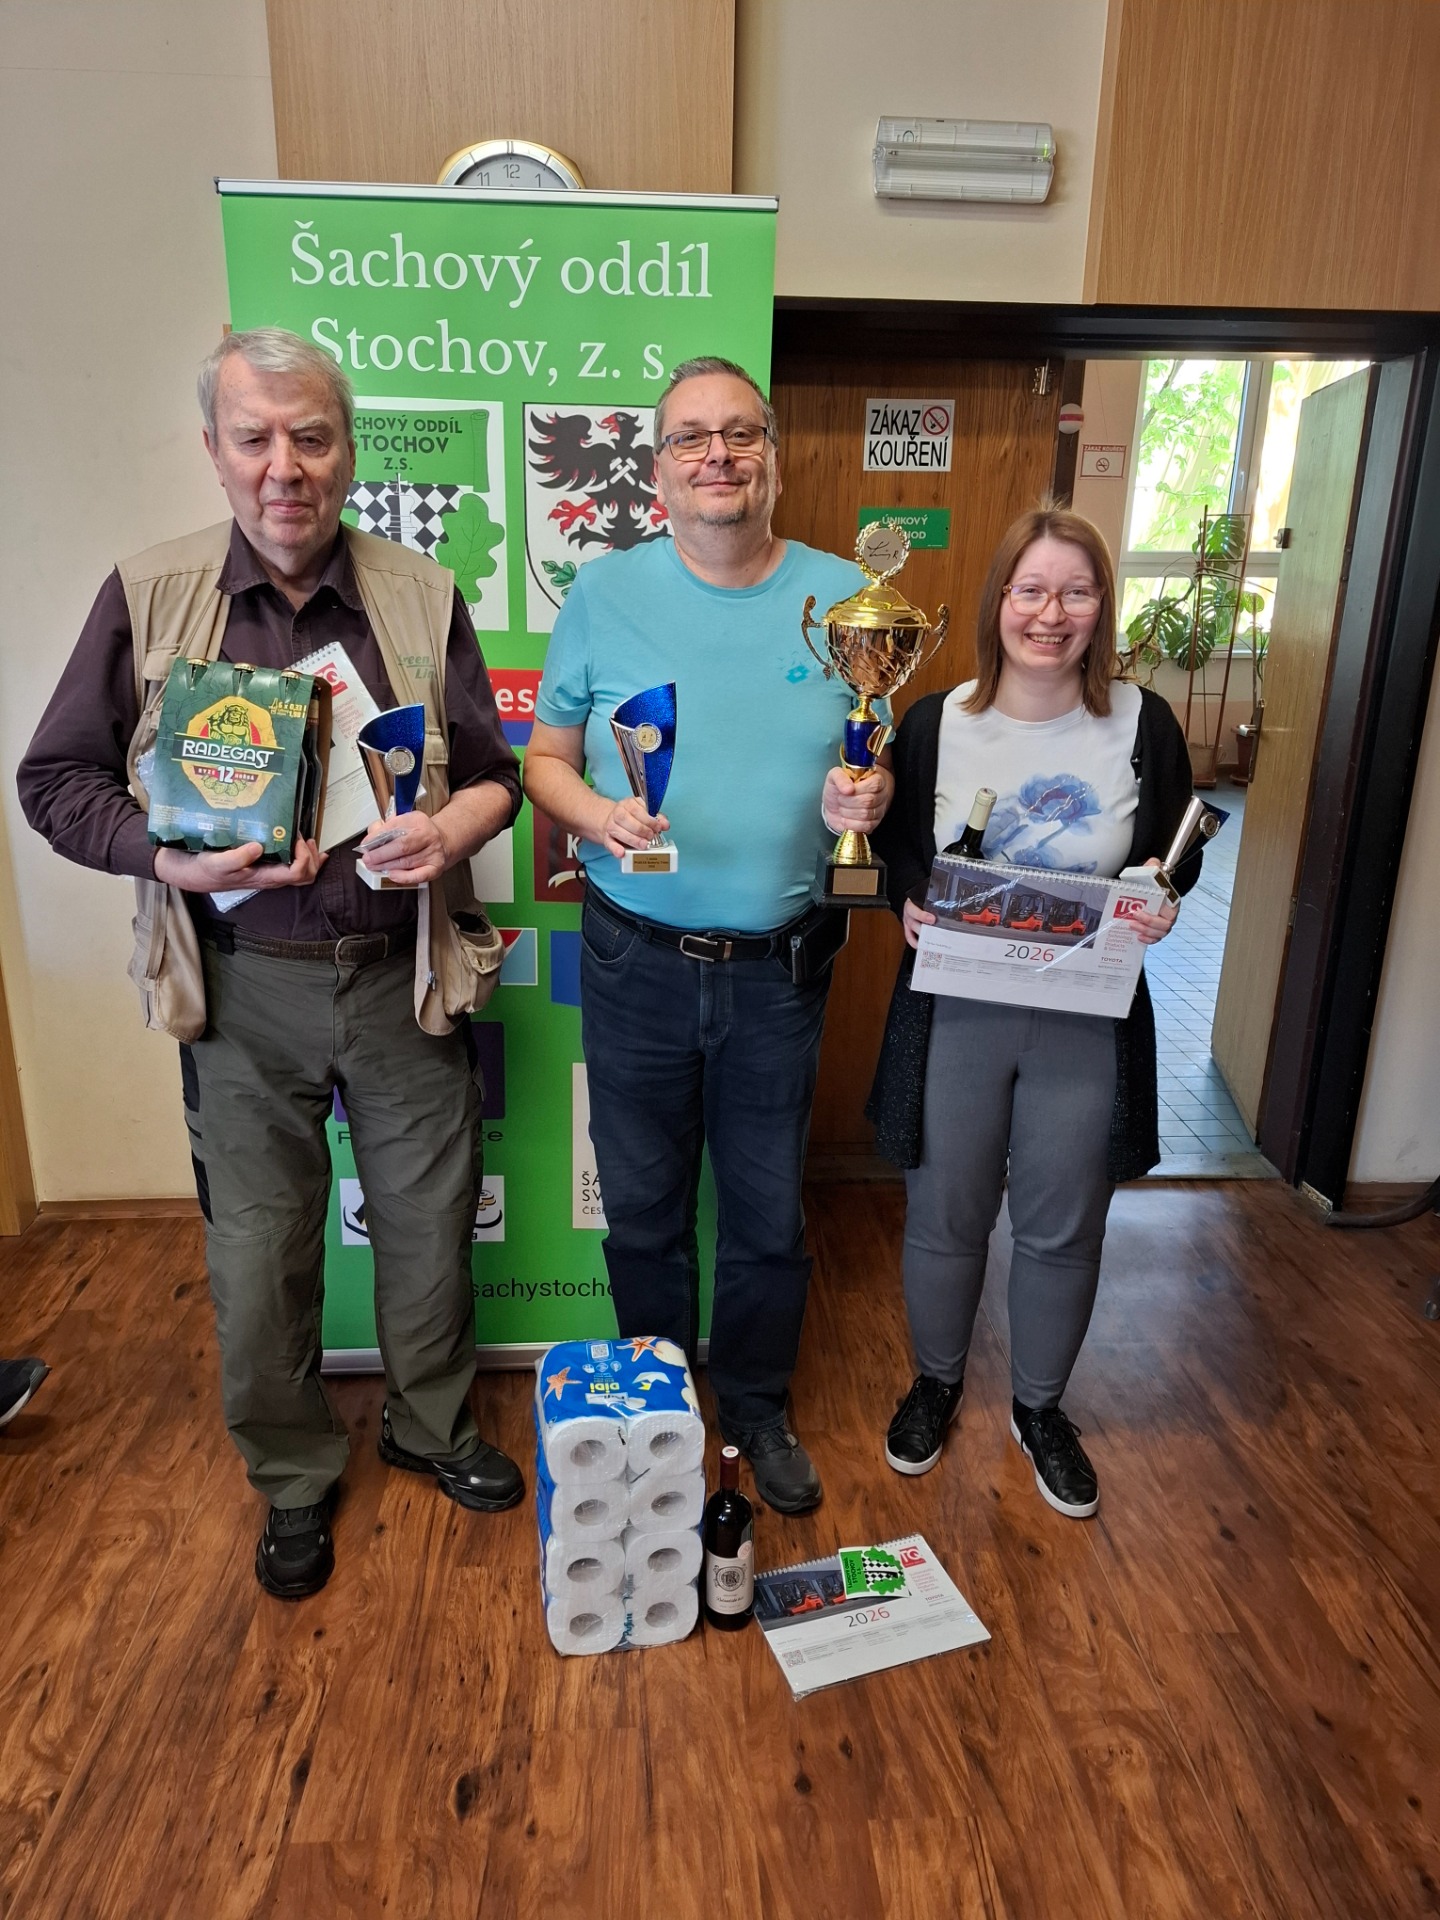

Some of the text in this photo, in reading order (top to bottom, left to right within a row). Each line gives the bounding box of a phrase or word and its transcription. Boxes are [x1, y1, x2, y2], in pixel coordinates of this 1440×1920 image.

[502, 163, 521, 179] 12
[291, 220, 713, 309] Šachový oddíl
[311, 316, 560, 386] Stochov,
[579, 340, 621, 379] z.
[353, 414, 463, 434] CHOVÝ ODDÍL
[870, 404, 921, 435] ZÁKAZ
[868, 435, 949, 467] KOUŘENÍ
[384, 457, 413, 470] Z.S.
[882, 513, 928, 526] ÚNIKOVÝ
[182, 740, 274, 769] RADEGAST
[217, 765, 235, 784] 12
[1004, 943, 1055, 963] 2026
[1101, 956, 1123, 964] TOYOTA
[844, 1606, 890, 1628] 2026
